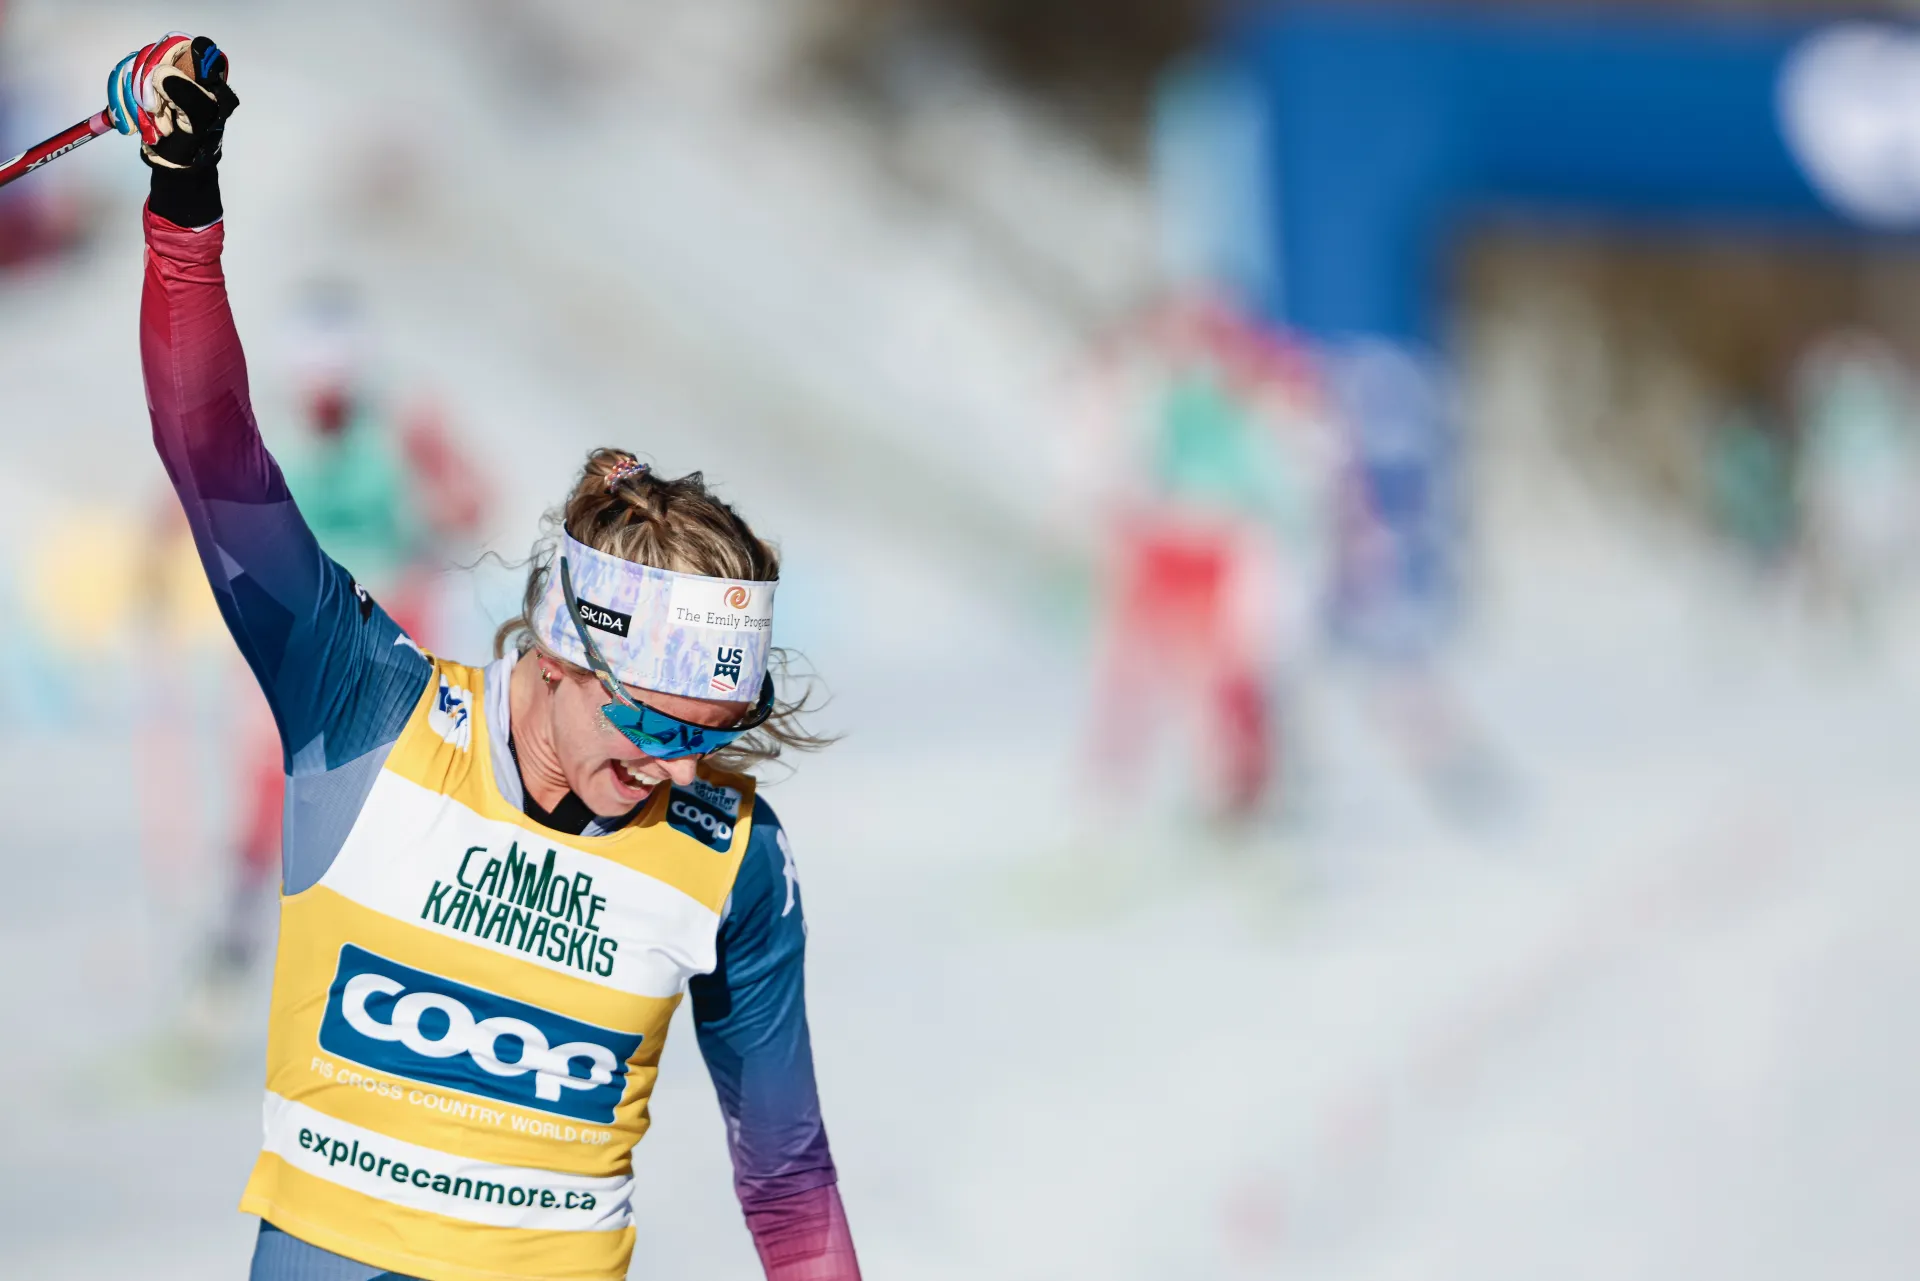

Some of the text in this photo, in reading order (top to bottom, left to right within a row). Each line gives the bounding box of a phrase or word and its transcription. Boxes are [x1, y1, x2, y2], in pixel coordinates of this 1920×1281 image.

[579, 604, 624, 632] SKIDA
[676, 607, 701, 622] The
[706, 611, 740, 629] Emily
[717, 646, 743, 665] US
[671, 800, 732, 840] coop
[420, 880, 618, 977] KANANASKIS
[341, 973, 618, 1102] coop
[311, 1056, 612, 1146] FIS CROSS COUNTRY WORLD CUP
[298, 1127, 597, 1211] explorecanmore.ca
